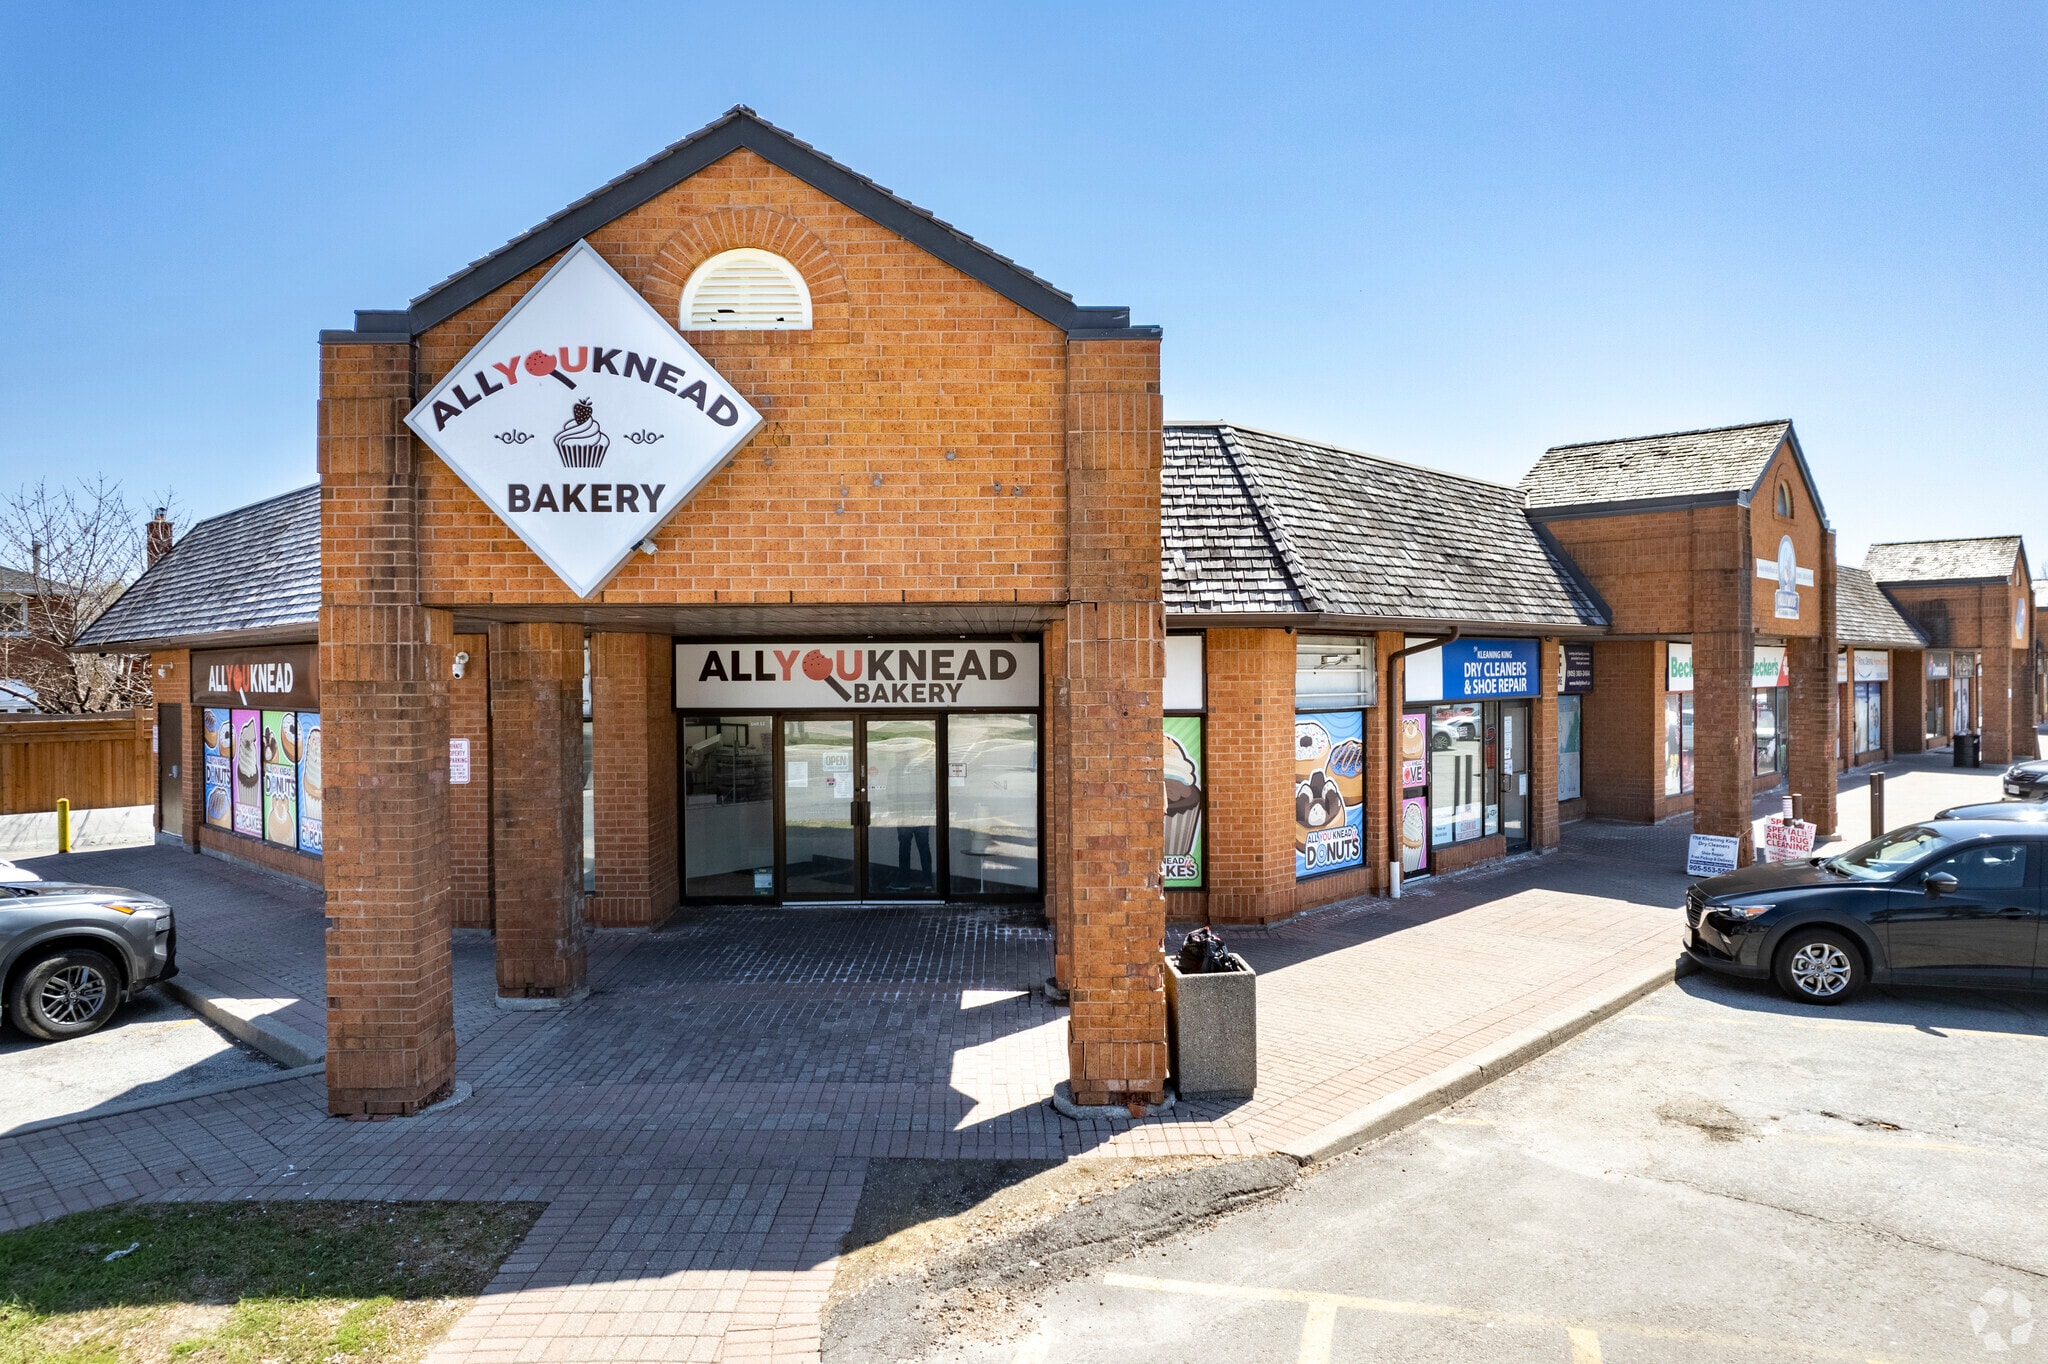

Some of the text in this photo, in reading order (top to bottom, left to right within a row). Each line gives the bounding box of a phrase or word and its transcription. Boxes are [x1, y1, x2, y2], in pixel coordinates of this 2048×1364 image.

[432, 345, 739, 432] ALLYOUKNEAD
[508, 483, 666, 513] BAKERY
[1477, 650, 1512, 659] KLEANING KING
[698, 649, 1018, 682] ALLYOUKNEAD
[1464, 662, 1527, 678] DRY CLEANERS
[1752, 657, 1779, 677] ecker's
[208, 662, 294, 695] ALLYOUKNEAD
[1464, 678, 1527, 695] & SHOE REPAIR
[854, 683, 963, 704] BAKERY
[825, 755, 847, 767] OPEN
[206, 766, 231, 785] DONUTS
[1403, 766, 1422, 782] OVE
[265, 775, 296, 798] DONUTS
[1308, 834, 1318, 844] ALL
[1319, 832, 1331, 842] YOU
[1333, 829, 1352, 840] KNEAD
[1766, 833, 1809, 845] AREA RUG
[1767, 826, 1807, 837] SPEIAL!!
[1702, 836, 1725, 844] Kleaning
[1766, 840, 1809, 852] CLEANING
[1307, 838, 1359, 866] DONUTS
[1166, 865, 1195, 877] KES
